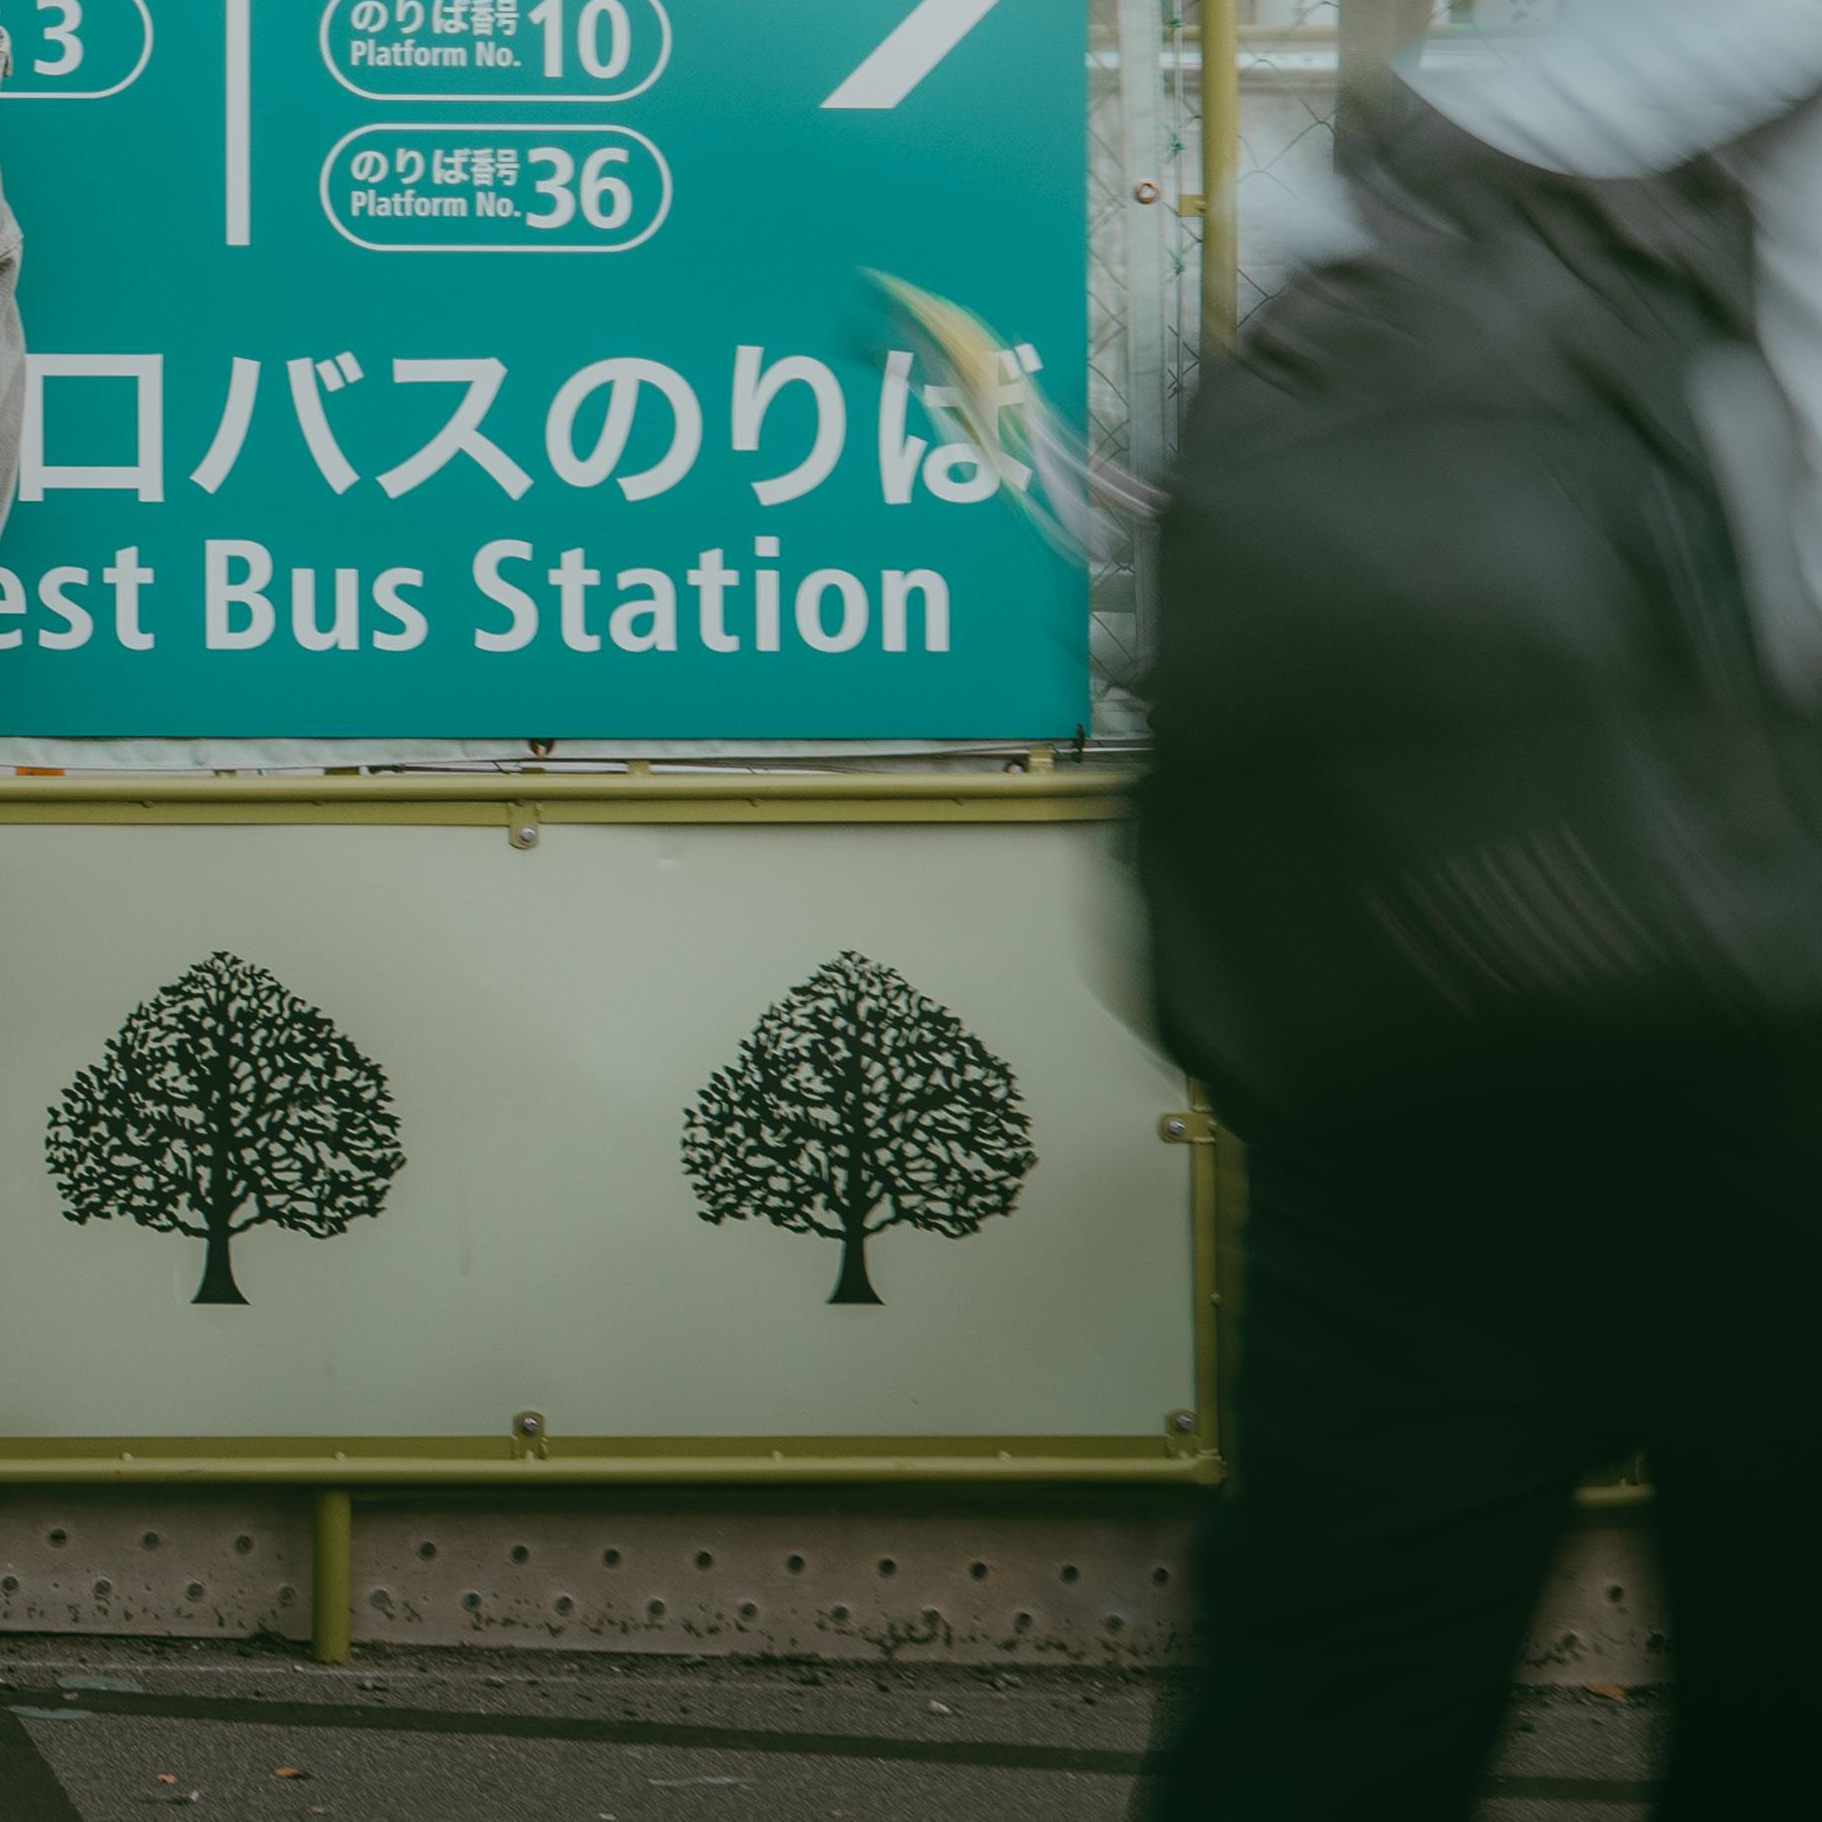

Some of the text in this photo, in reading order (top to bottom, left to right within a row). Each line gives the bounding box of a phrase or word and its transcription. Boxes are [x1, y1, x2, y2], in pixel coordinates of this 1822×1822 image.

[351, 40, 521, 68] Platform No.
[351, 147, 519, 186] のりば番号
[525, 146, 632, 231] 36
[351, 190, 521, 219] Platform No.
[18, 343, 1042, 506] 口バスのりば
[204, 538, 429, 653] Bus
[472, 534, 953, 654] Station
